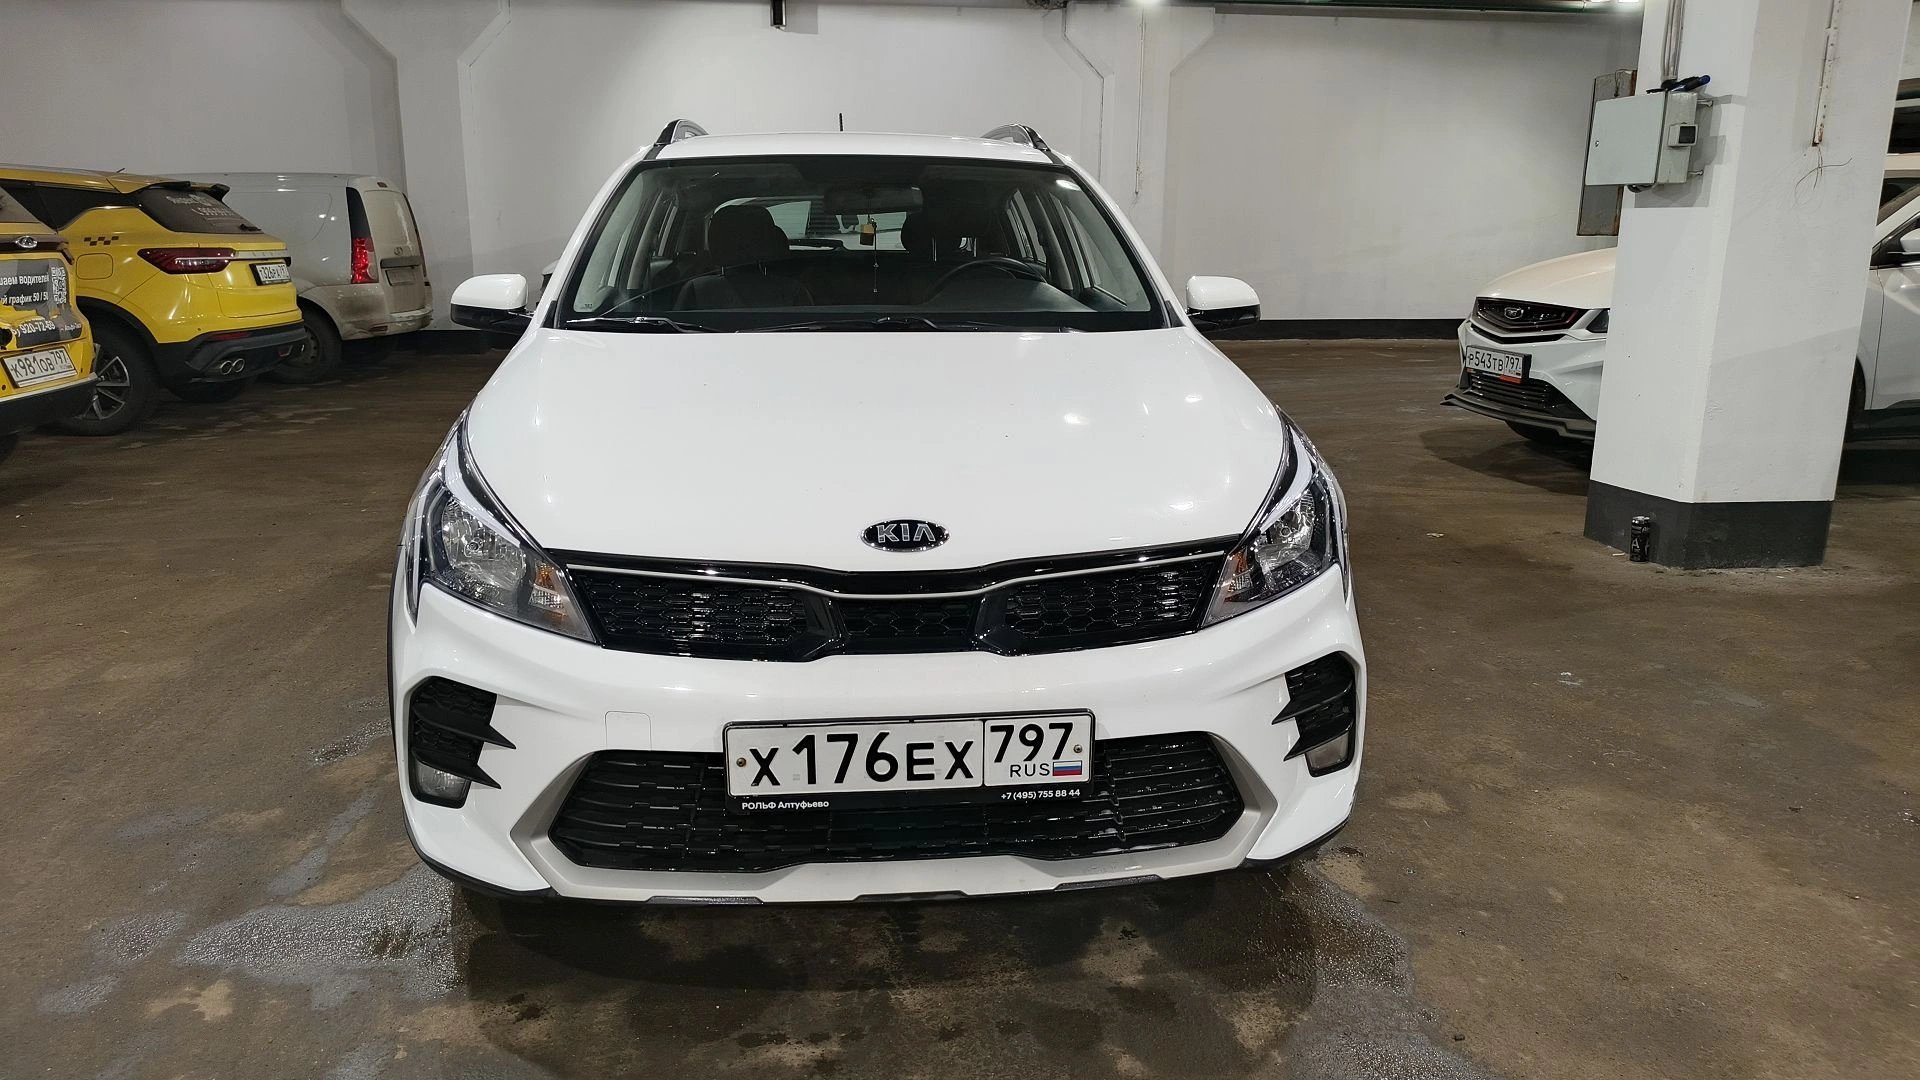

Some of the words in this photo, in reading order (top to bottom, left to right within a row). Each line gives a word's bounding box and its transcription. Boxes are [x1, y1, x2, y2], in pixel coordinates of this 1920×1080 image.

[9, 294, 33, 306] график
[1505, 355, 1520, 370] 797
[876, 523, 936, 544] KIA
[989, 721, 1074, 764] 797
[1009, 762, 1050, 778] RUS
[1001, 792, 1012, 800] +7
[1013, 791, 1037, 800] (495)
[1038, 790, 1054, 799] 755
[1055, 789, 1067, 798] 88
[1068, 788, 1081, 797] 44
[741, 801, 777, 810] РОЛЬФ
[777, 800, 830, 810] Алтуфьево
